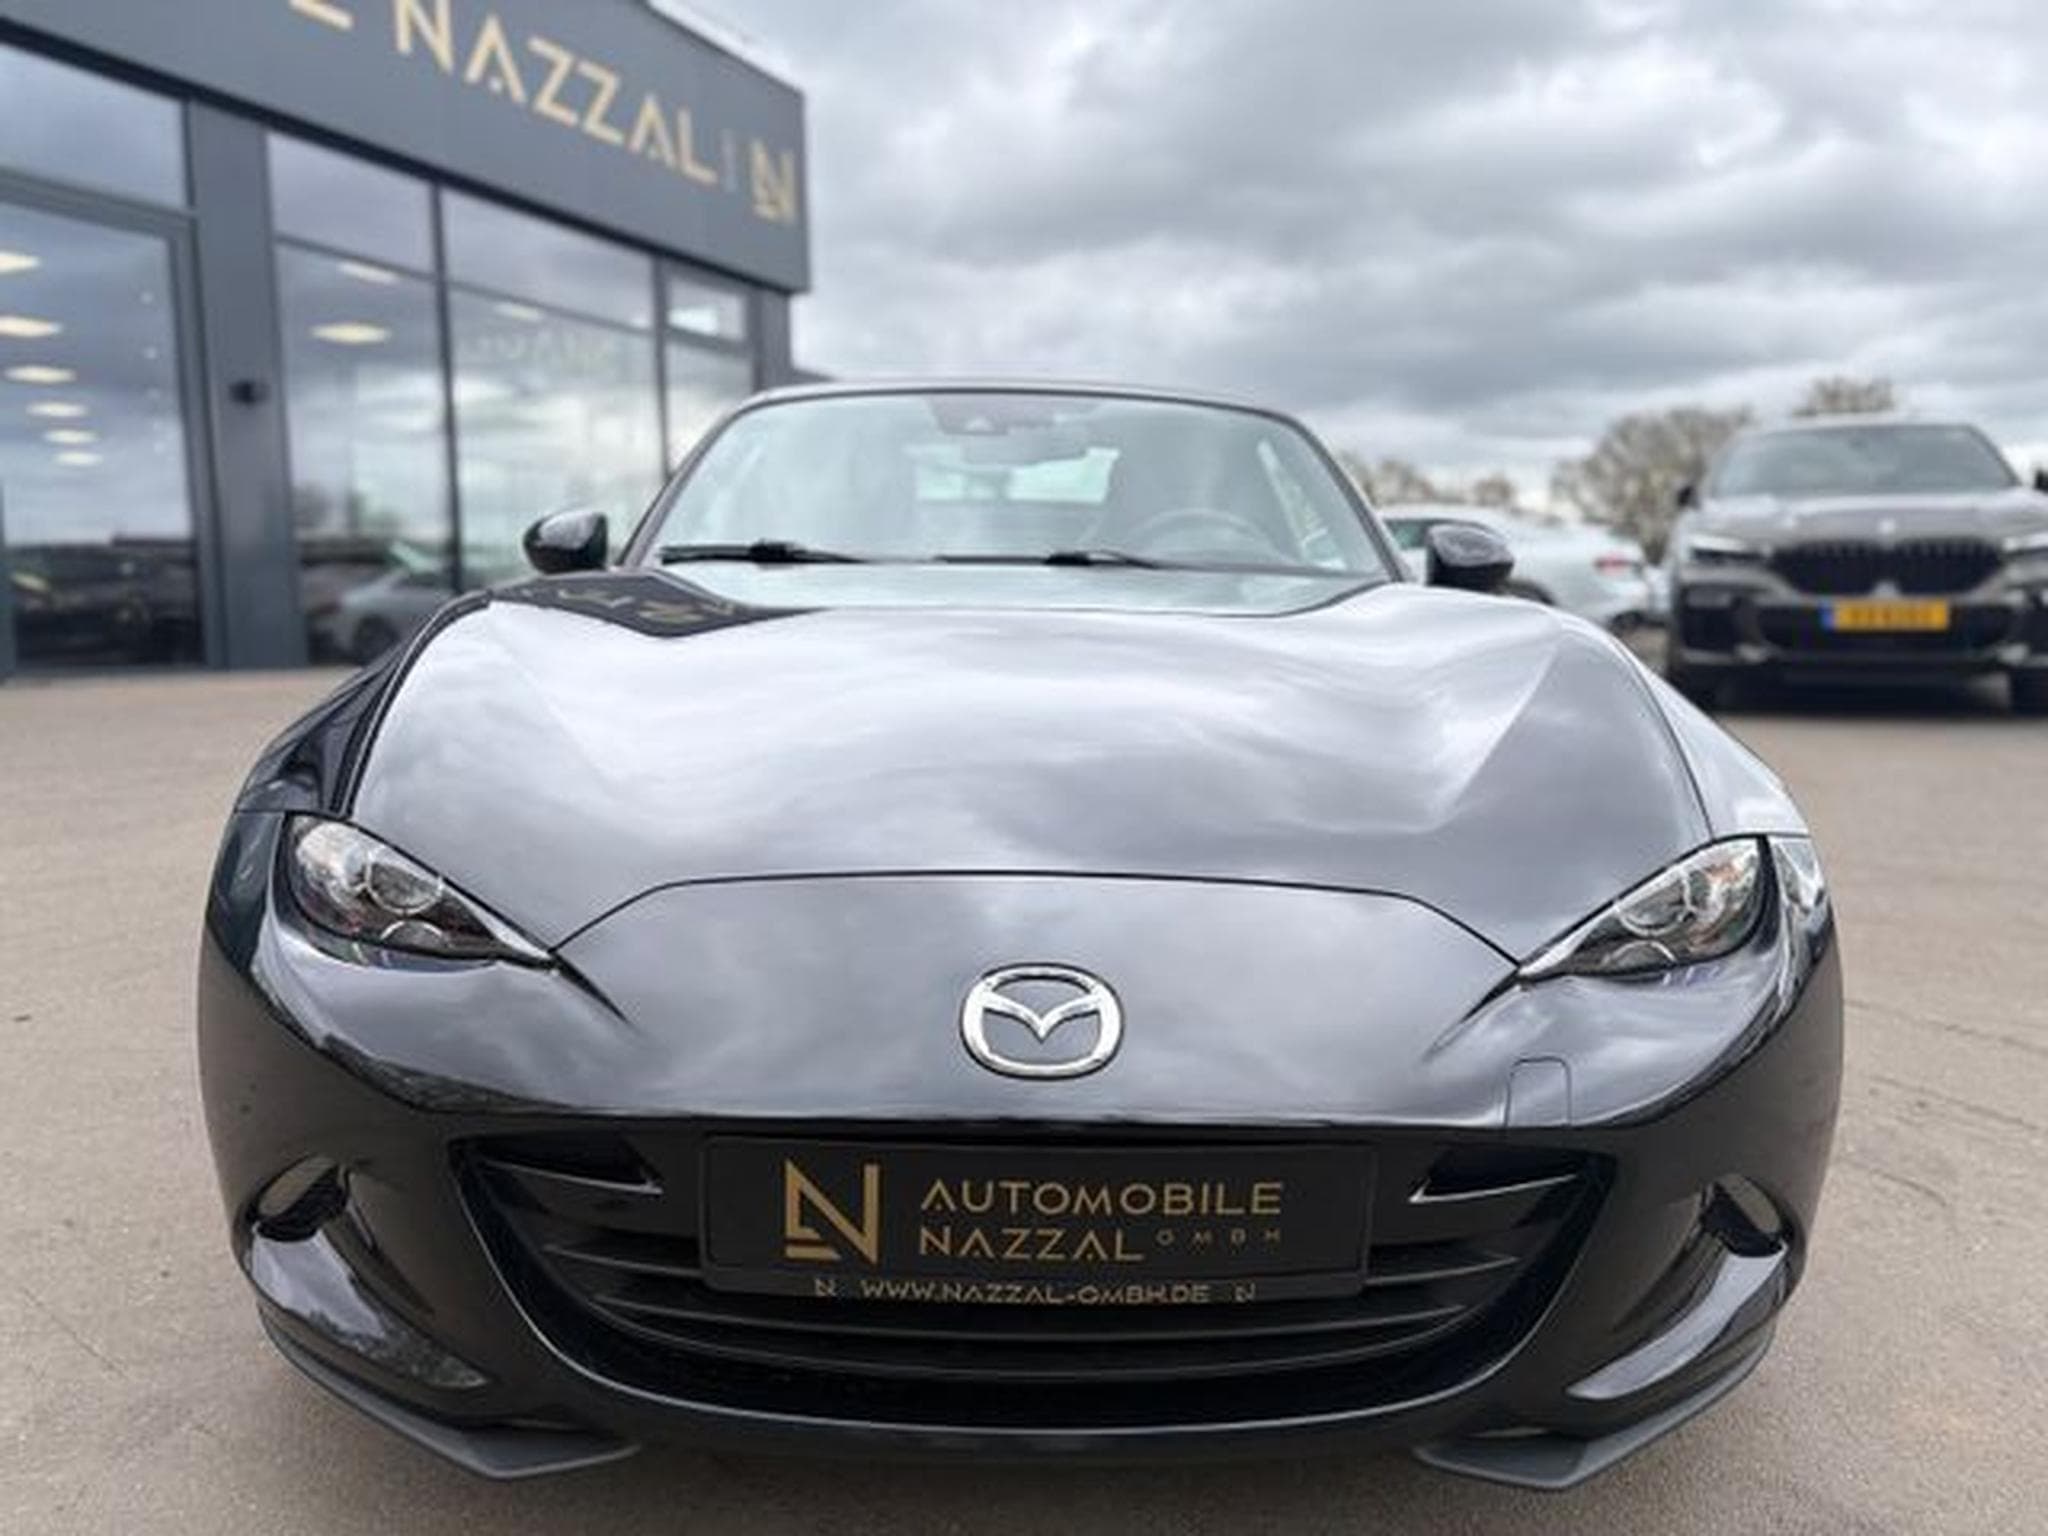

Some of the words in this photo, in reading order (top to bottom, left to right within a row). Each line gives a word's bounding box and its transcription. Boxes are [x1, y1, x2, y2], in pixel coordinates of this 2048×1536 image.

[396, 0, 717, 184] NAZZAL
[920, 1179, 1283, 1216] AUTOMOBILE
[919, 1226, 1145, 1262] NAZZAL
